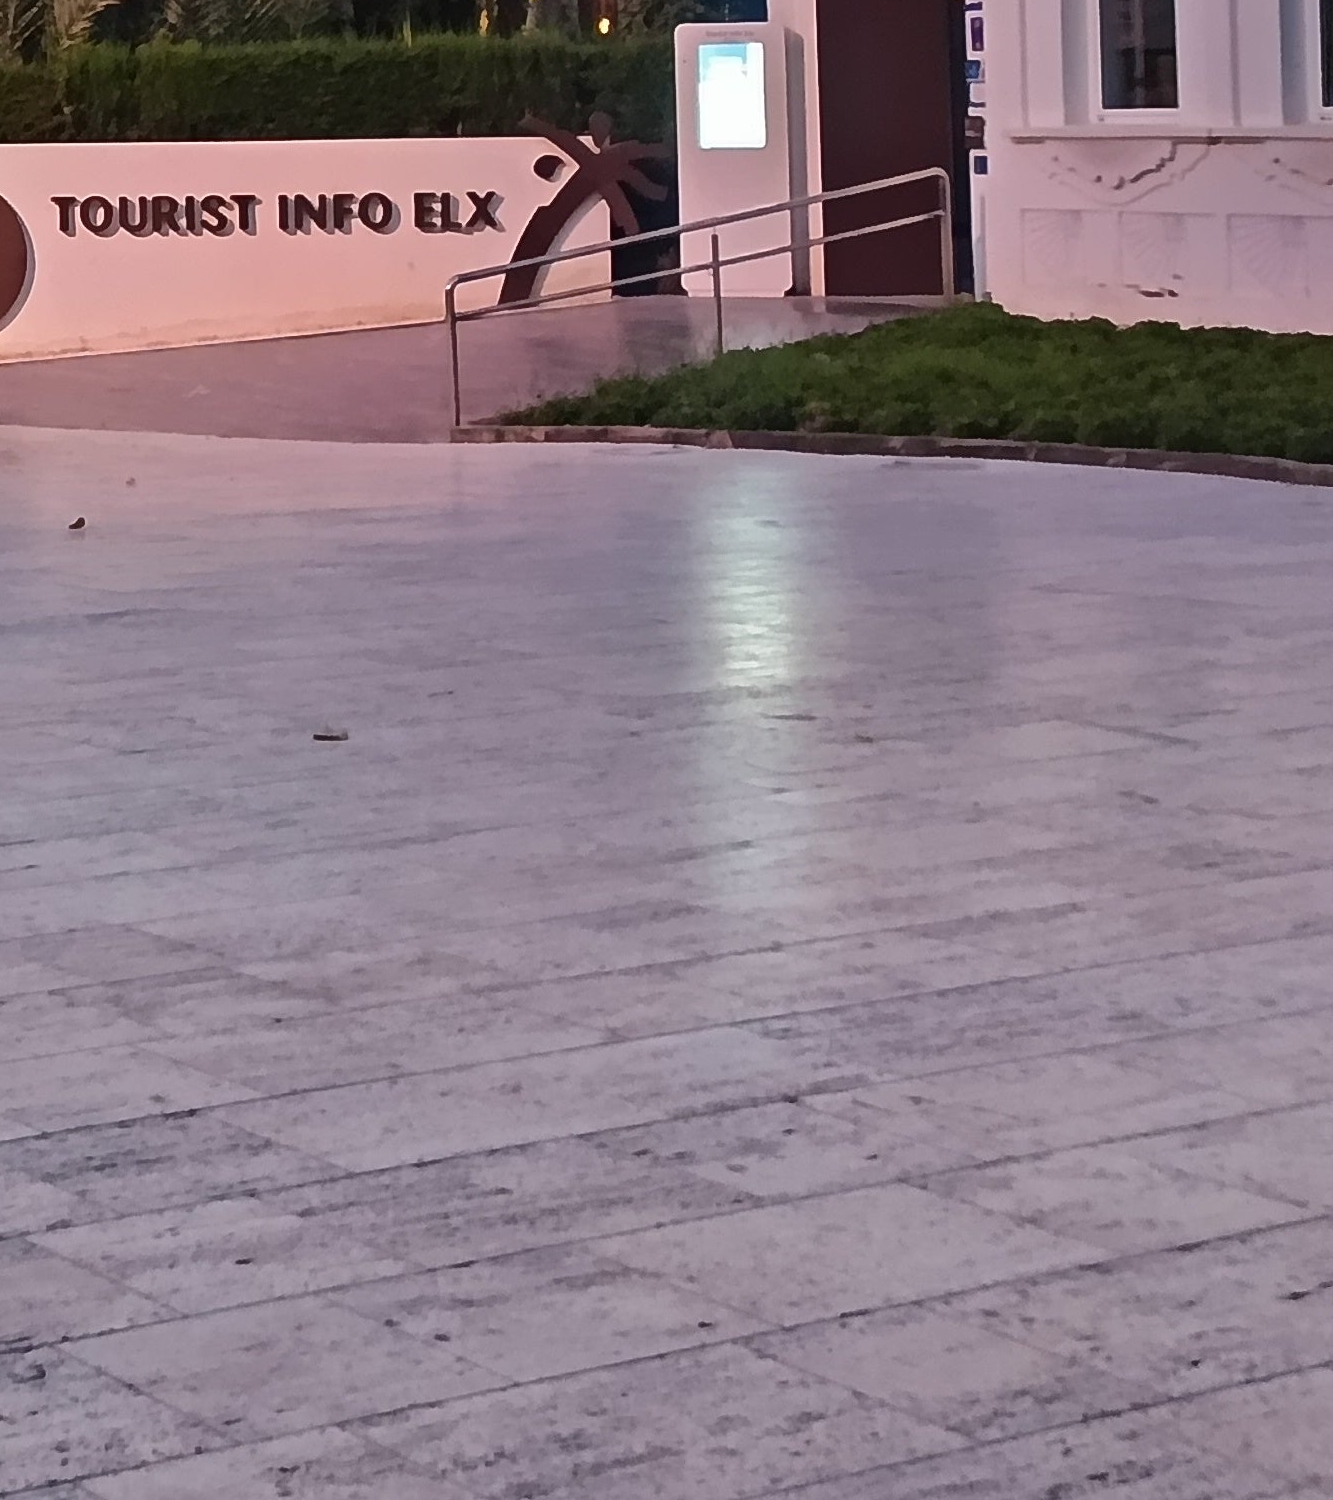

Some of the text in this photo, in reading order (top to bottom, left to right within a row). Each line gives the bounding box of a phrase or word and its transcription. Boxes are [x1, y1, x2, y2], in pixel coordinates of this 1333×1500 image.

[51, 190, 503, 236] TOURIST INFO ELX
